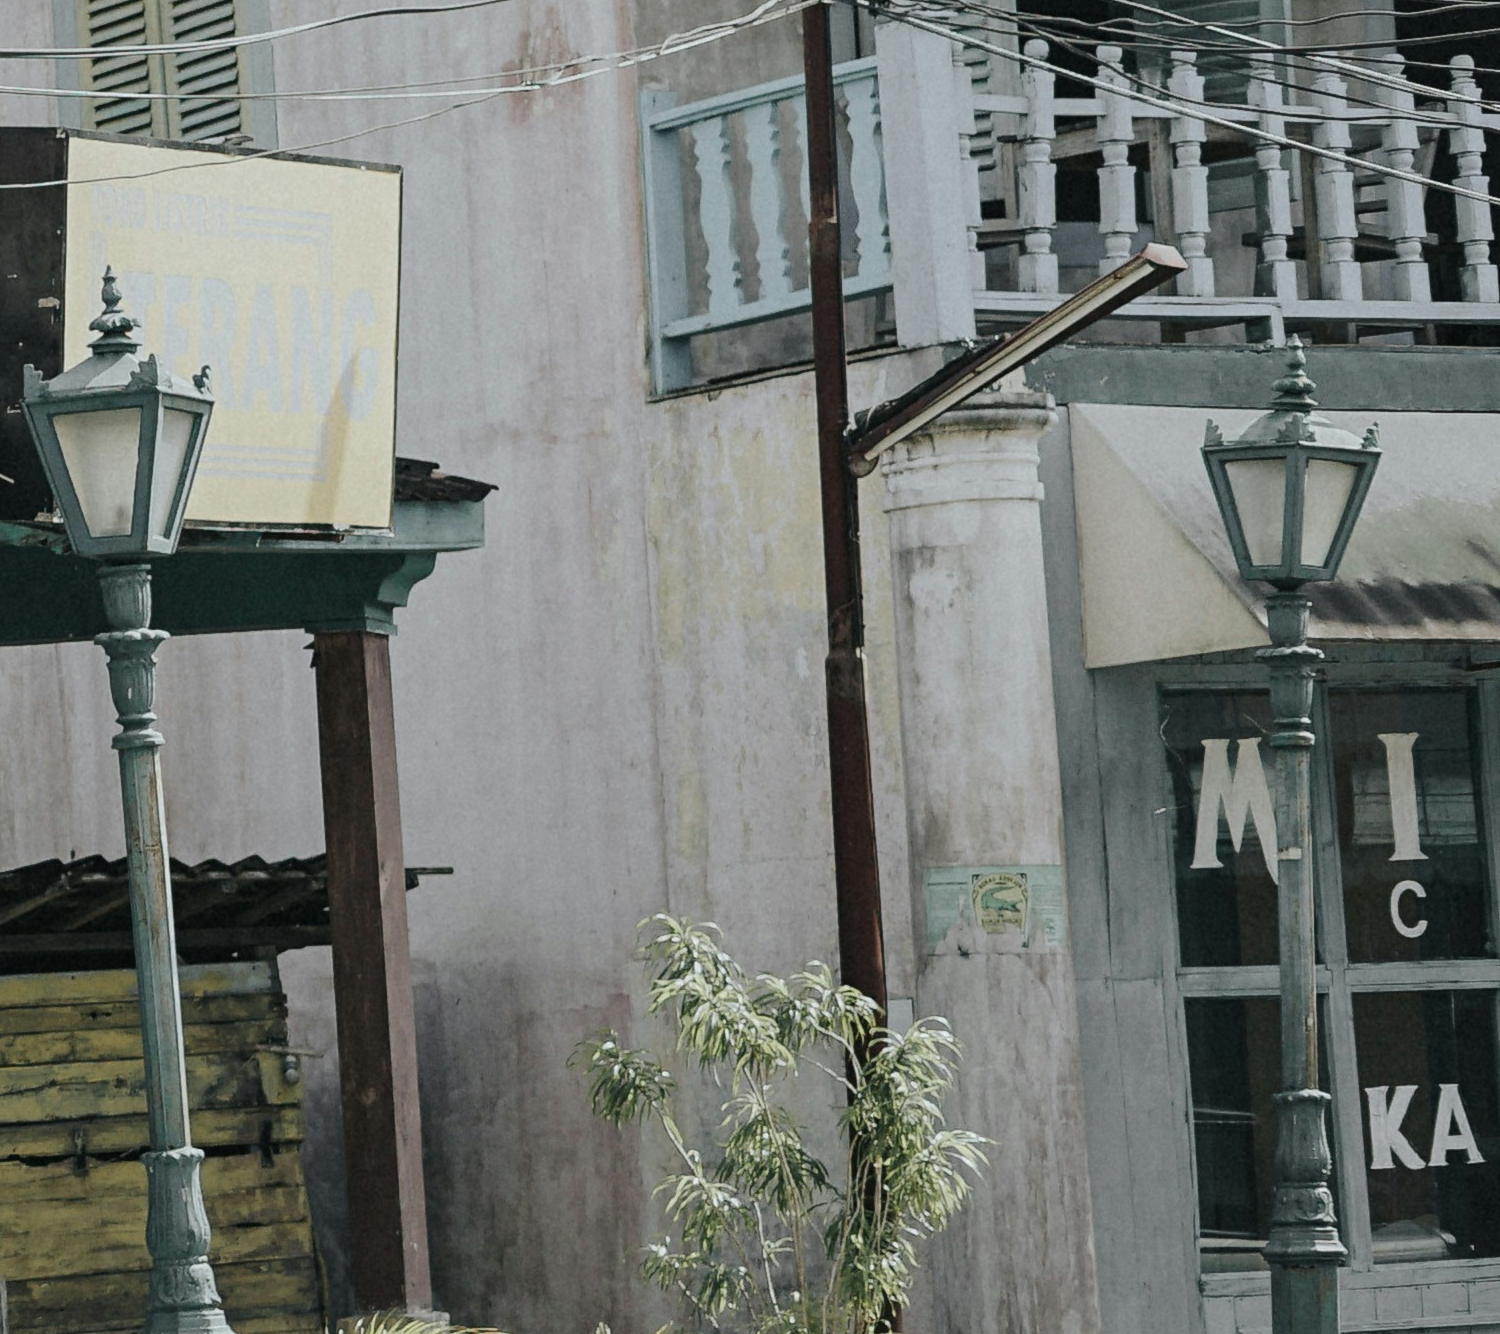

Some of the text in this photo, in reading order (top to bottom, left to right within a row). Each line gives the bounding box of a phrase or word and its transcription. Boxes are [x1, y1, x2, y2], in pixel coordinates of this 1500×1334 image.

[90, 183, 148, 230] TOKO
[122, 270, 380, 421] TERANG
[1390, 879, 1429, 939] C
[1364, 1083, 1487, 1170] KA
